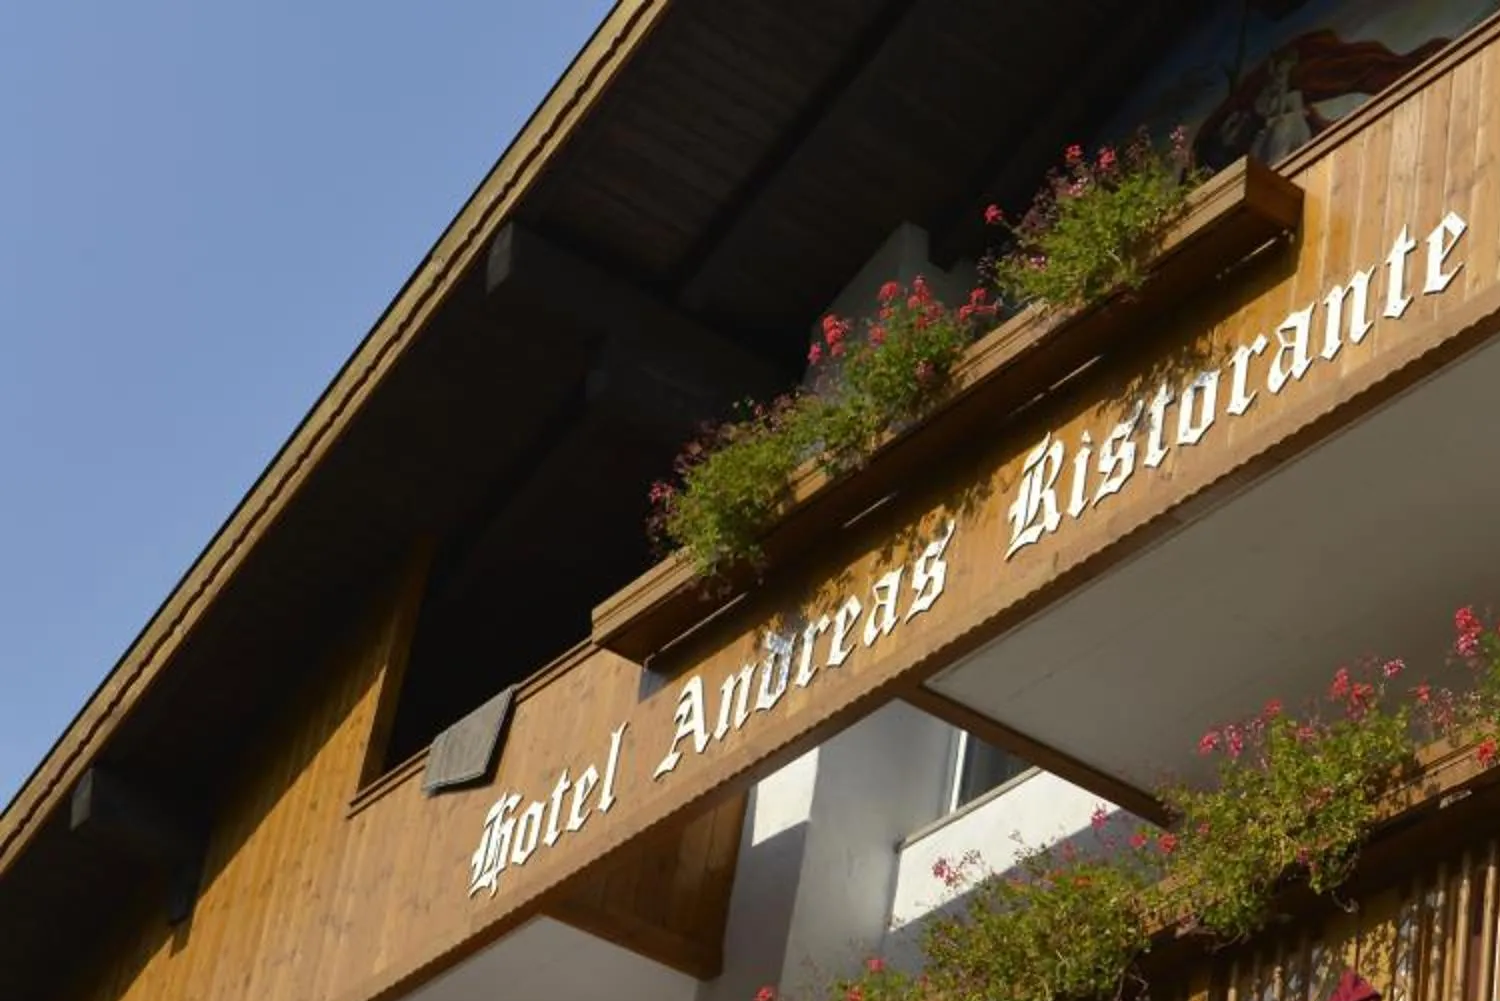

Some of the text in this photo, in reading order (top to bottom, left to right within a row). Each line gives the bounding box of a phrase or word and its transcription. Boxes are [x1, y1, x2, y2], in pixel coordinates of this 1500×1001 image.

[467, 209, 1467, 898] Hotel Andreas Ristorante
